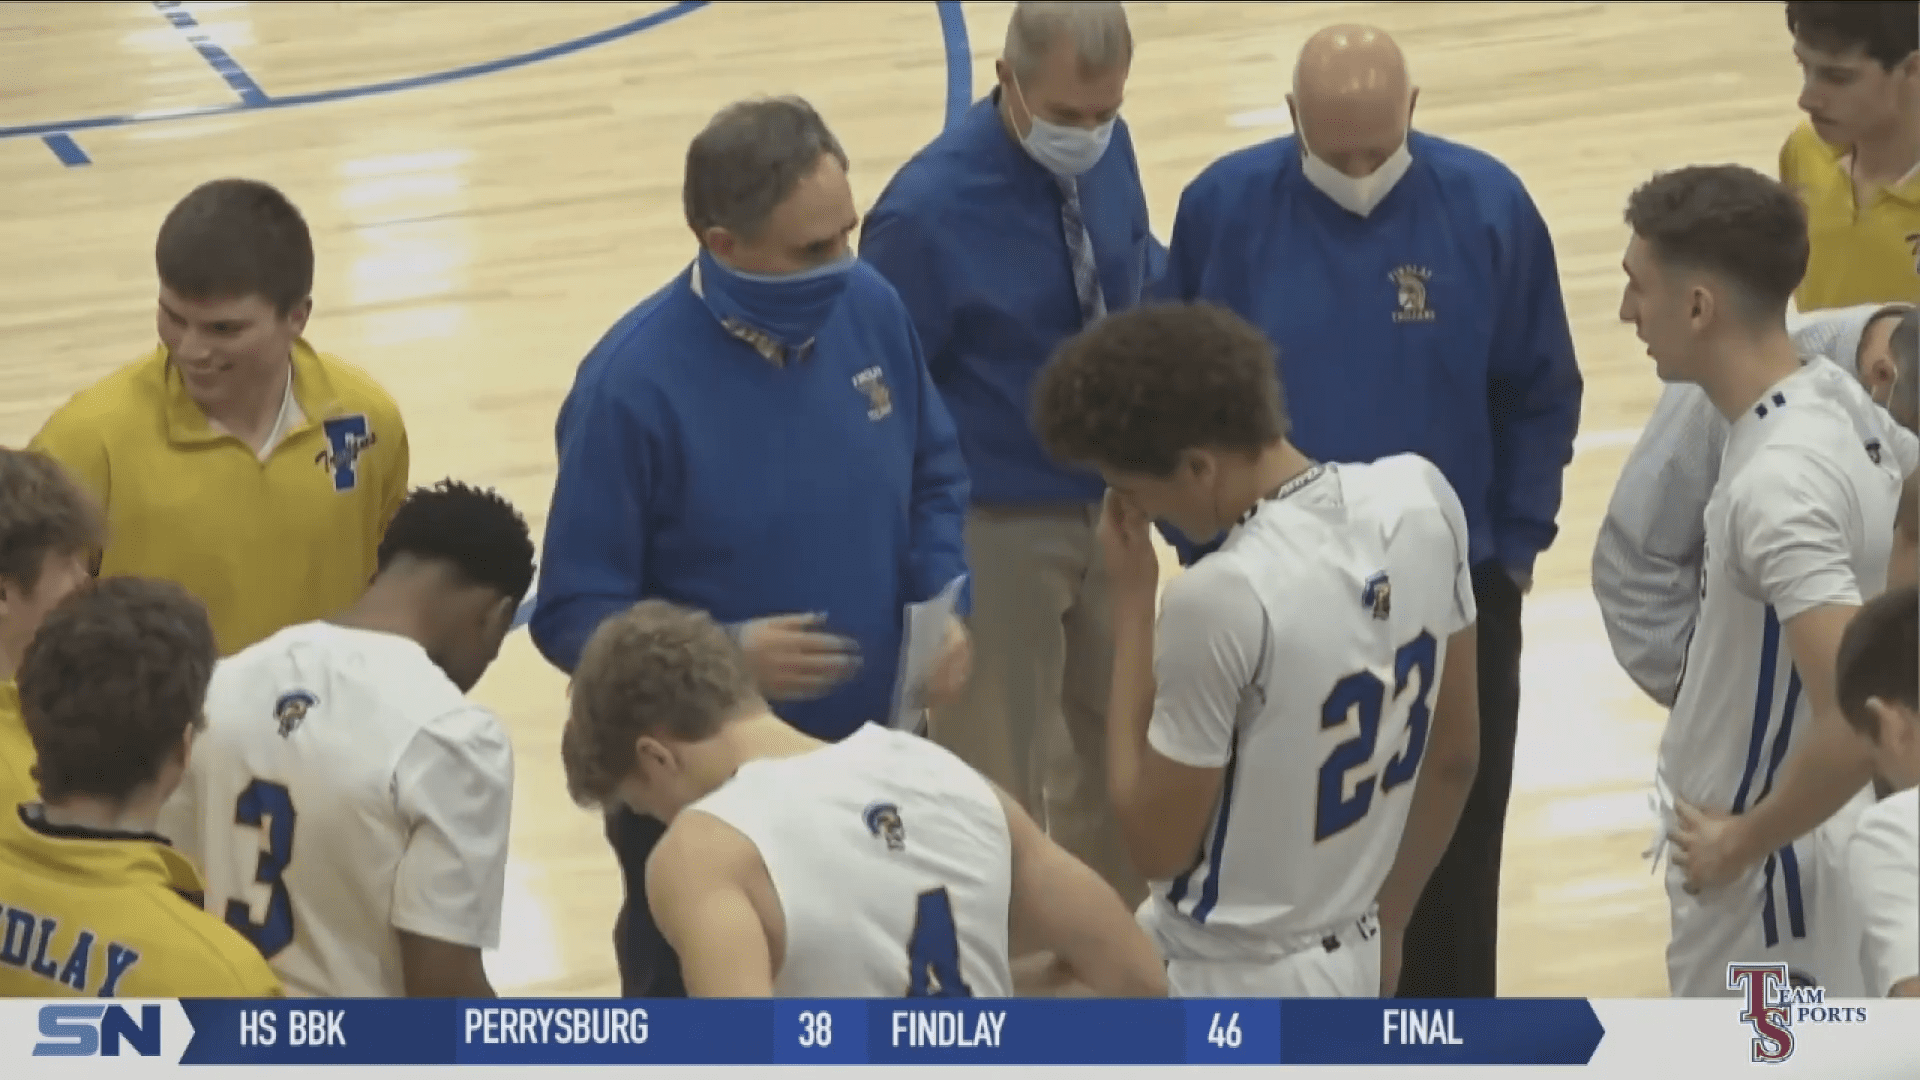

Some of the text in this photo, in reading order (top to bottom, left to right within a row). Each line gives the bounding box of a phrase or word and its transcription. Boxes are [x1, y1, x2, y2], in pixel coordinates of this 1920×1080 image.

[1313, 626, 1438, 844] 23
[0, 905, 140, 997] DLAY
[225, 777, 297, 961] 3
